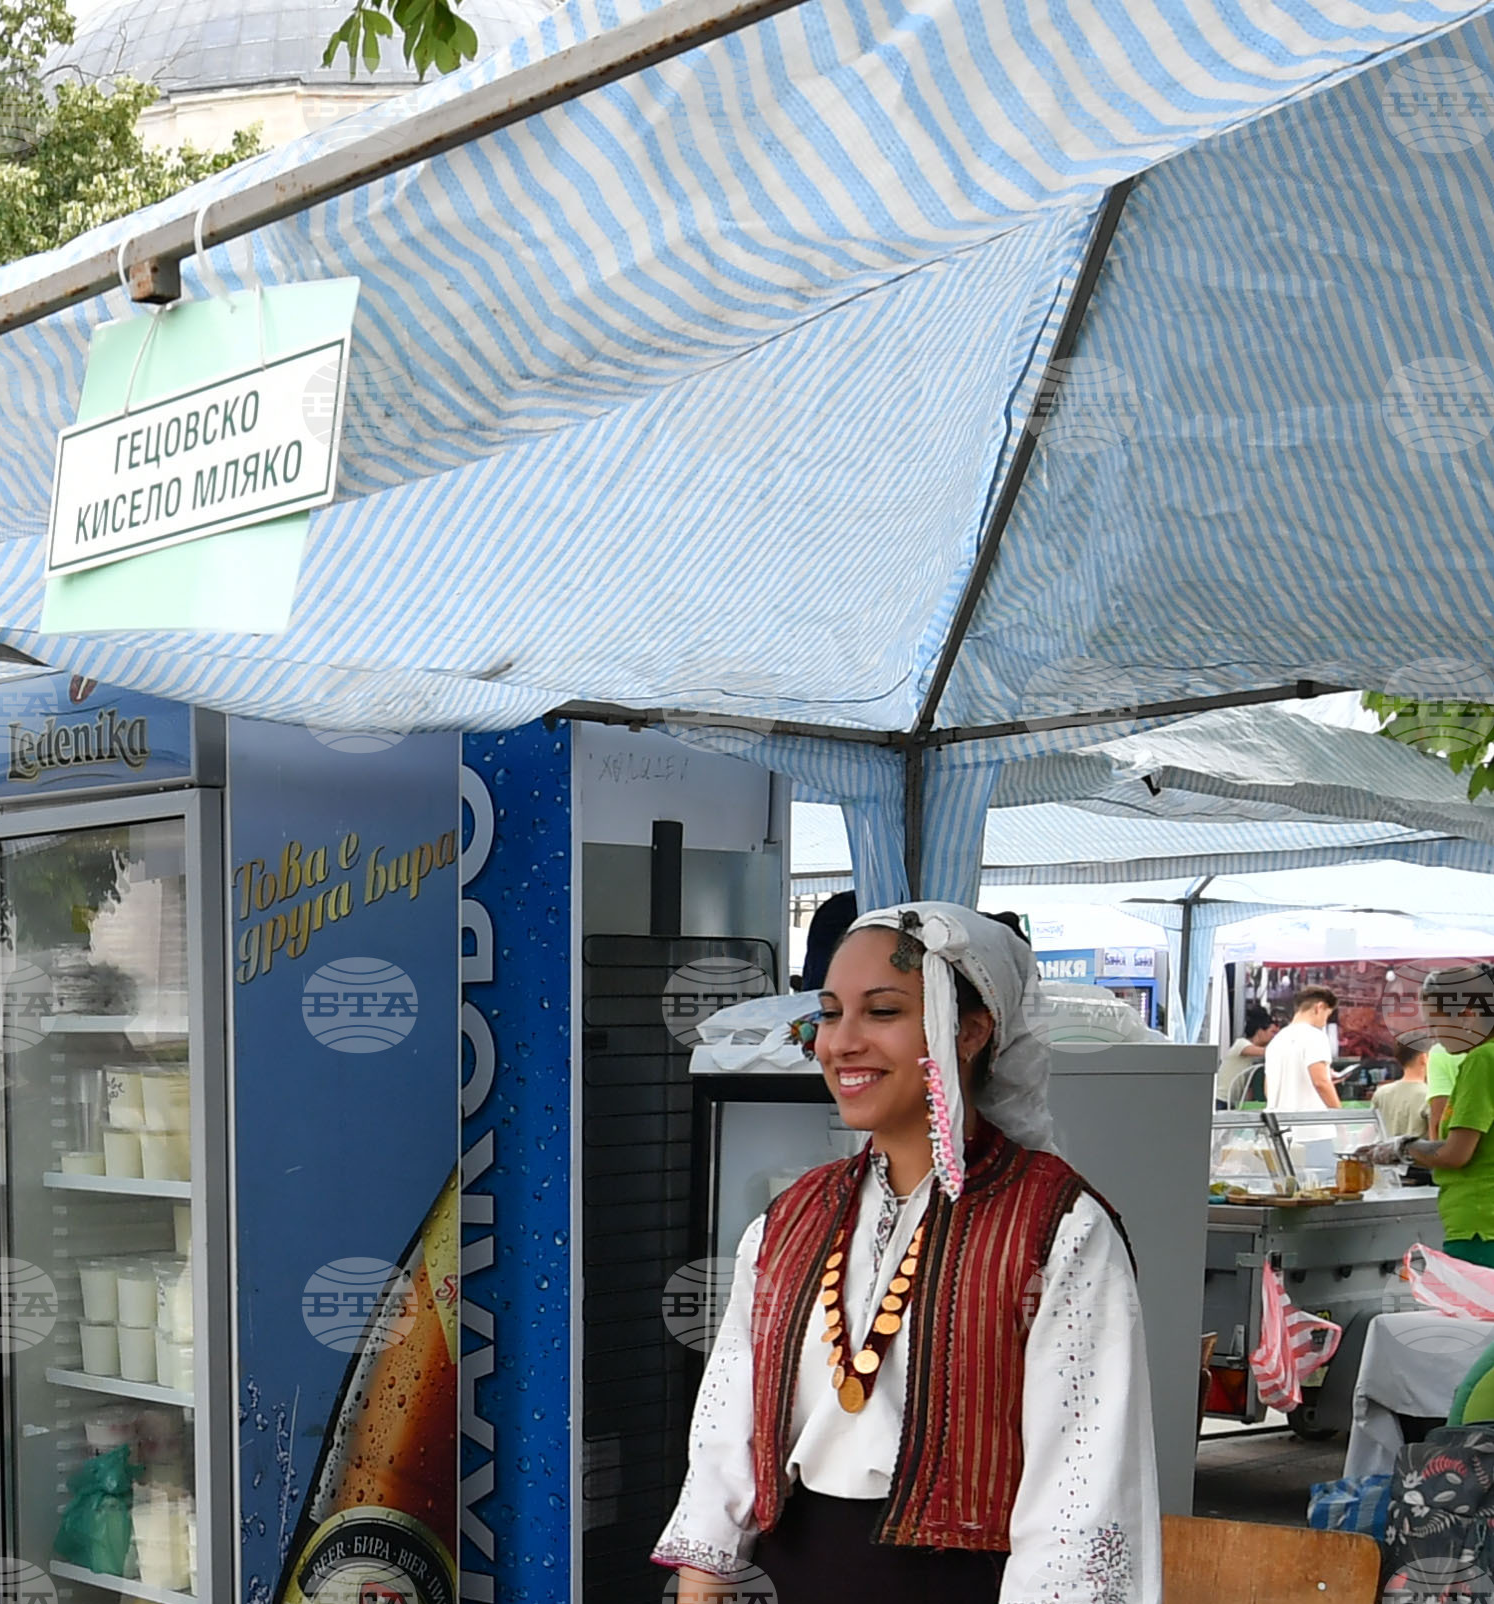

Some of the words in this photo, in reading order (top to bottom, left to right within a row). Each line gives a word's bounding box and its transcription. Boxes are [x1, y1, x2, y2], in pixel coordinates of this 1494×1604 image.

[113, 389, 261, 476] ГЕЦОВСКО
[74, 479, 181, 545] КИСЕЛО
[191, 440, 303, 512] МЛЯКО
[7, 706, 150, 782] Ledenika
[231, 840, 329, 920] Това
[338, 832, 361, 870] е
[312, 1539, 347, 1581] BEER
[354, 1535, 391, 1561] БИРА
[397, 1547, 429, 1584] BIER
